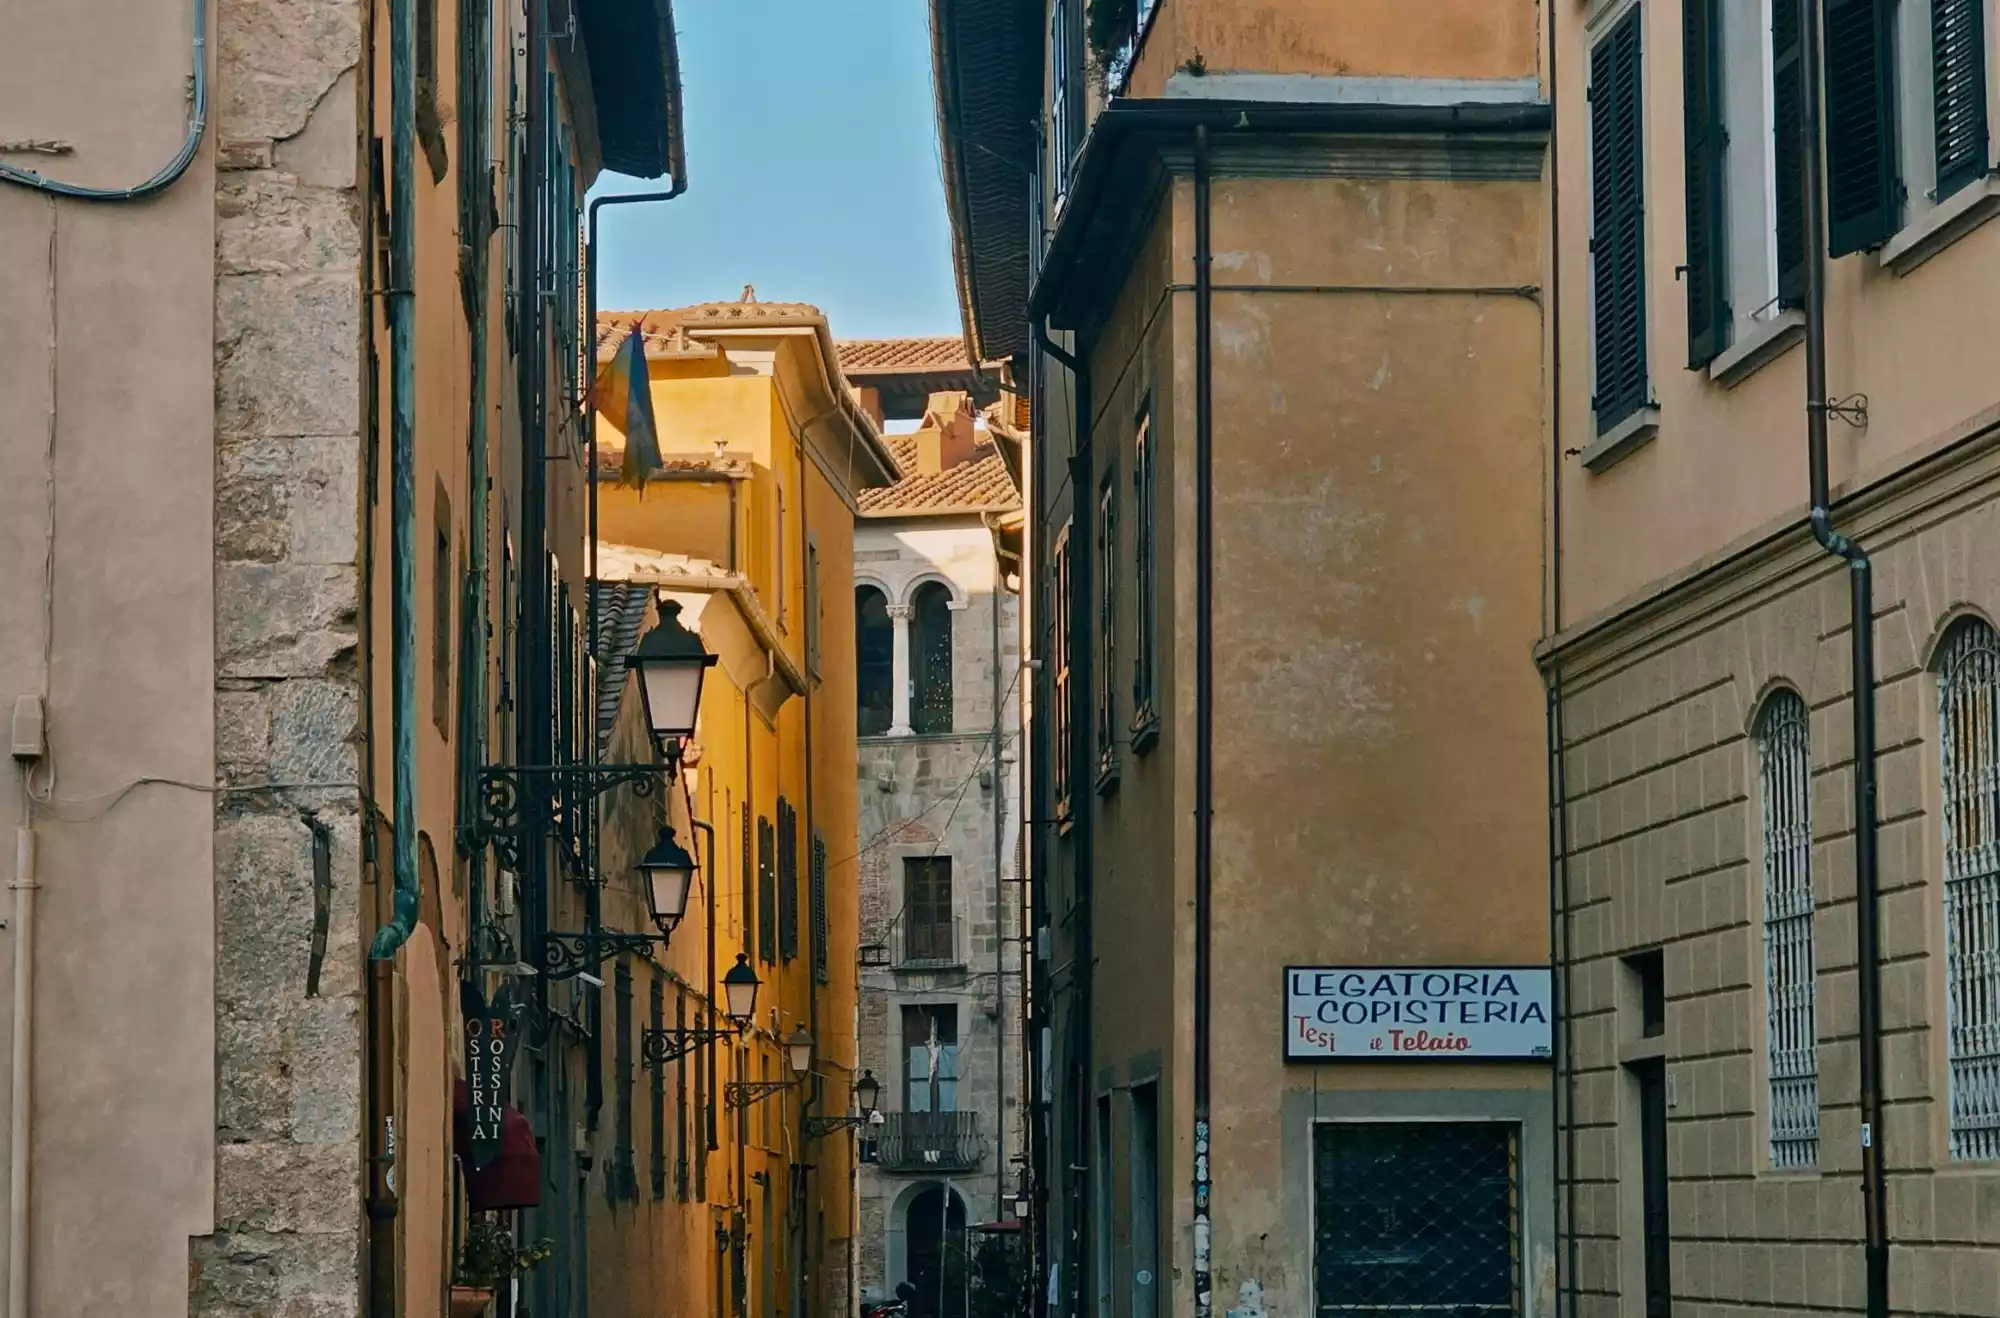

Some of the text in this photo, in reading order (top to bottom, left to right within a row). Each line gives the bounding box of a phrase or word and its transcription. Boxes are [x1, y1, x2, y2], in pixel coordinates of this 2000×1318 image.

[1292, 973, 1520, 997] LEGATORIA
[1317, 1000, 1547, 1025] COPISTERIA
[1293, 1015, 1336, 1052] Tesi
[1370, 1029, 1472, 1051] il Telaio
[466, 1018, 487, 1140] OSTERIA
[488, 1018, 506, 1140] ROSSINI
